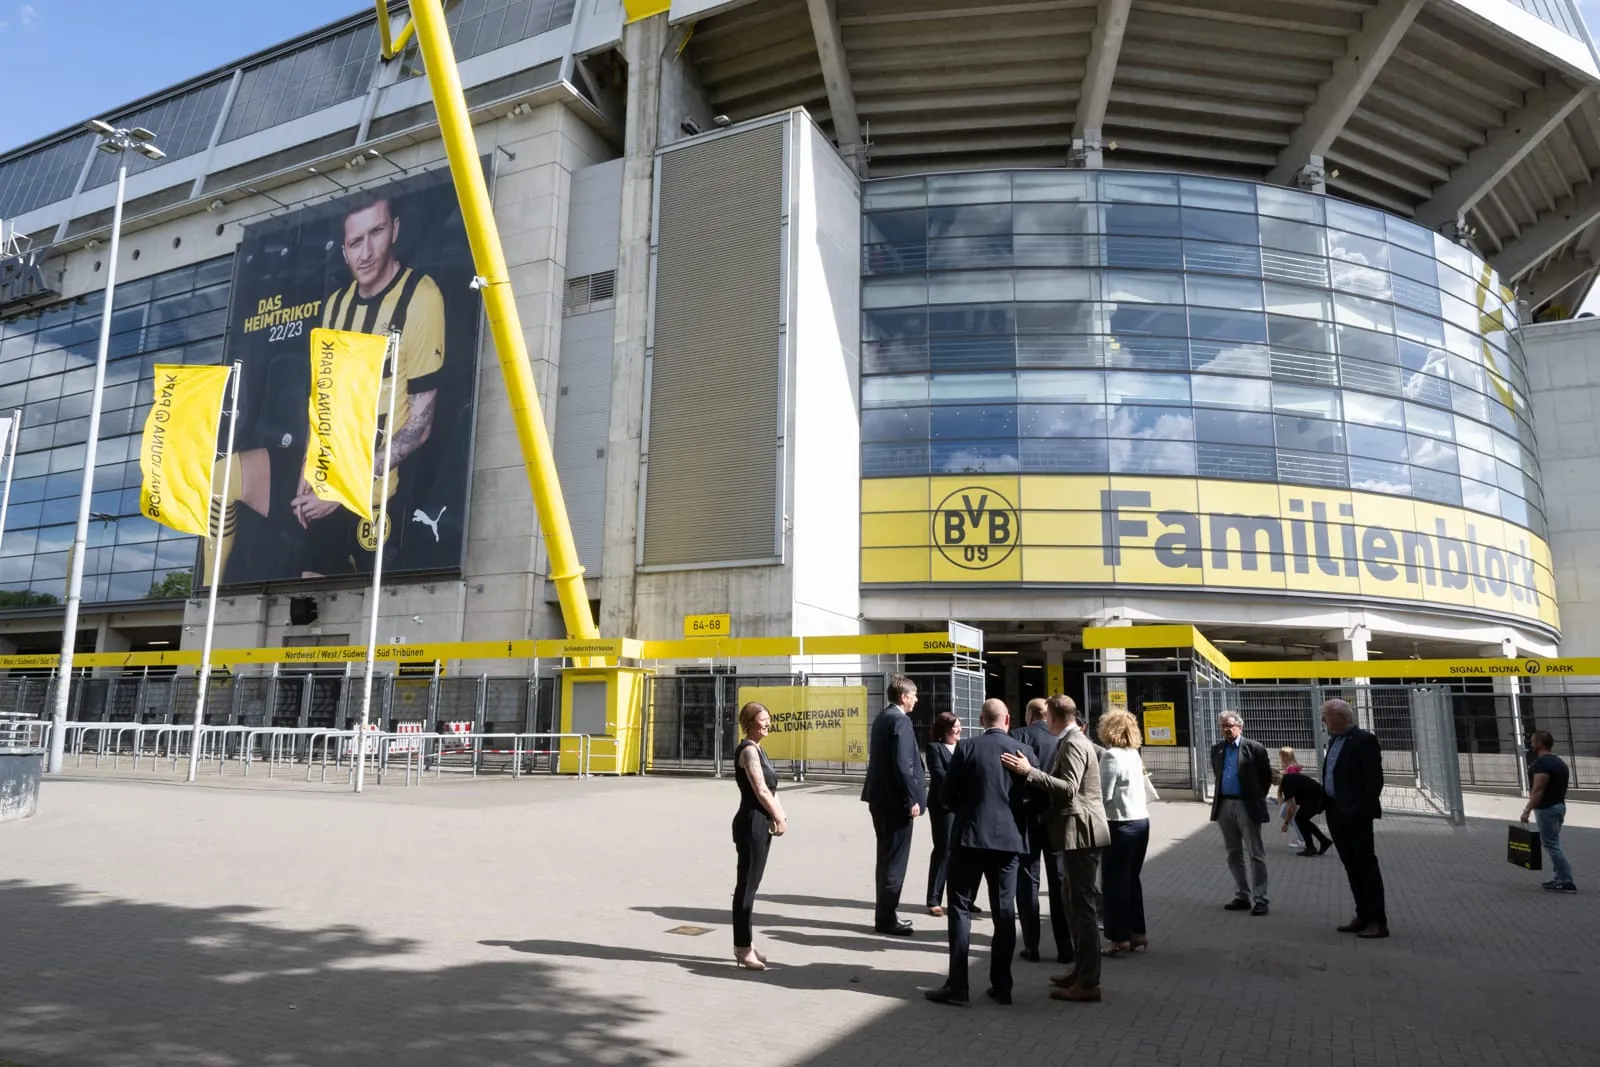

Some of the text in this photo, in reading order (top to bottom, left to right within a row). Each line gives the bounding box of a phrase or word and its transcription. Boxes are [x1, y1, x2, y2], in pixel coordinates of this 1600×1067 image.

[258, 294, 282, 315] DAS
[244, 300, 322, 334] HEIMTRIKOT
[268, 320, 303, 342] 22/23
[944, 494, 1010, 545] BVB
[963, 545, 988, 562] 09
[1100, 490, 1541, 607] Familienblock
[693, 620, 721, 630] 64-68
[284, 651, 316, 659] Nordwest
[321, 650, 337, 658] West
[342, 648, 368, 658] Südwes
[376, 649, 390, 658] Süd
[392, 648, 424, 657] Tribünen
[1449, 666, 1486, 674] SIGNAL
[1546, 665, 1575, 673] PARK
[847, 707, 859, 717] IM
[784, 721, 814, 733] IDUNA
[815, 719, 841, 729] PARK
